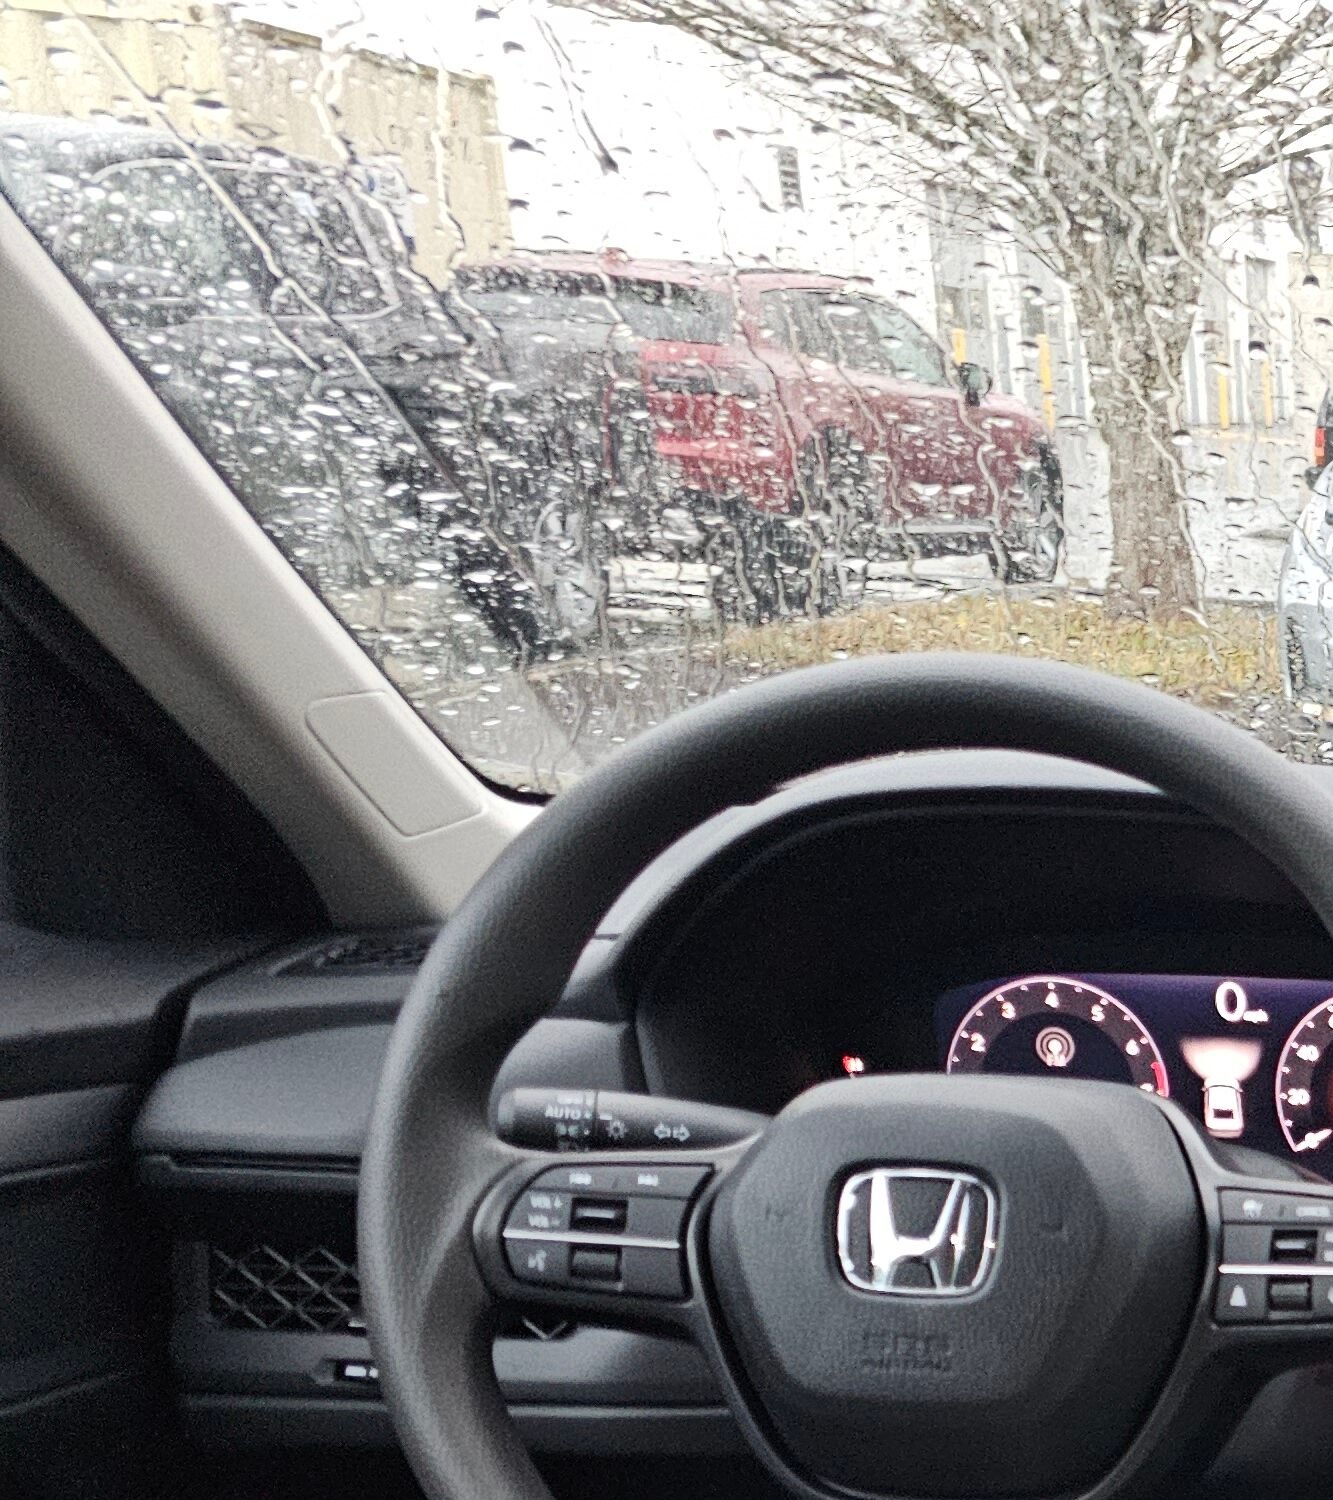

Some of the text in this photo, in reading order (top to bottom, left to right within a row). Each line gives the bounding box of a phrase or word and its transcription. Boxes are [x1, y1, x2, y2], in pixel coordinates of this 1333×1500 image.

[1215, 981, 1247, 1021] 0
[970, 1032, 986, 1053] 2
[545, 1104, 582, 1120] AUTO
